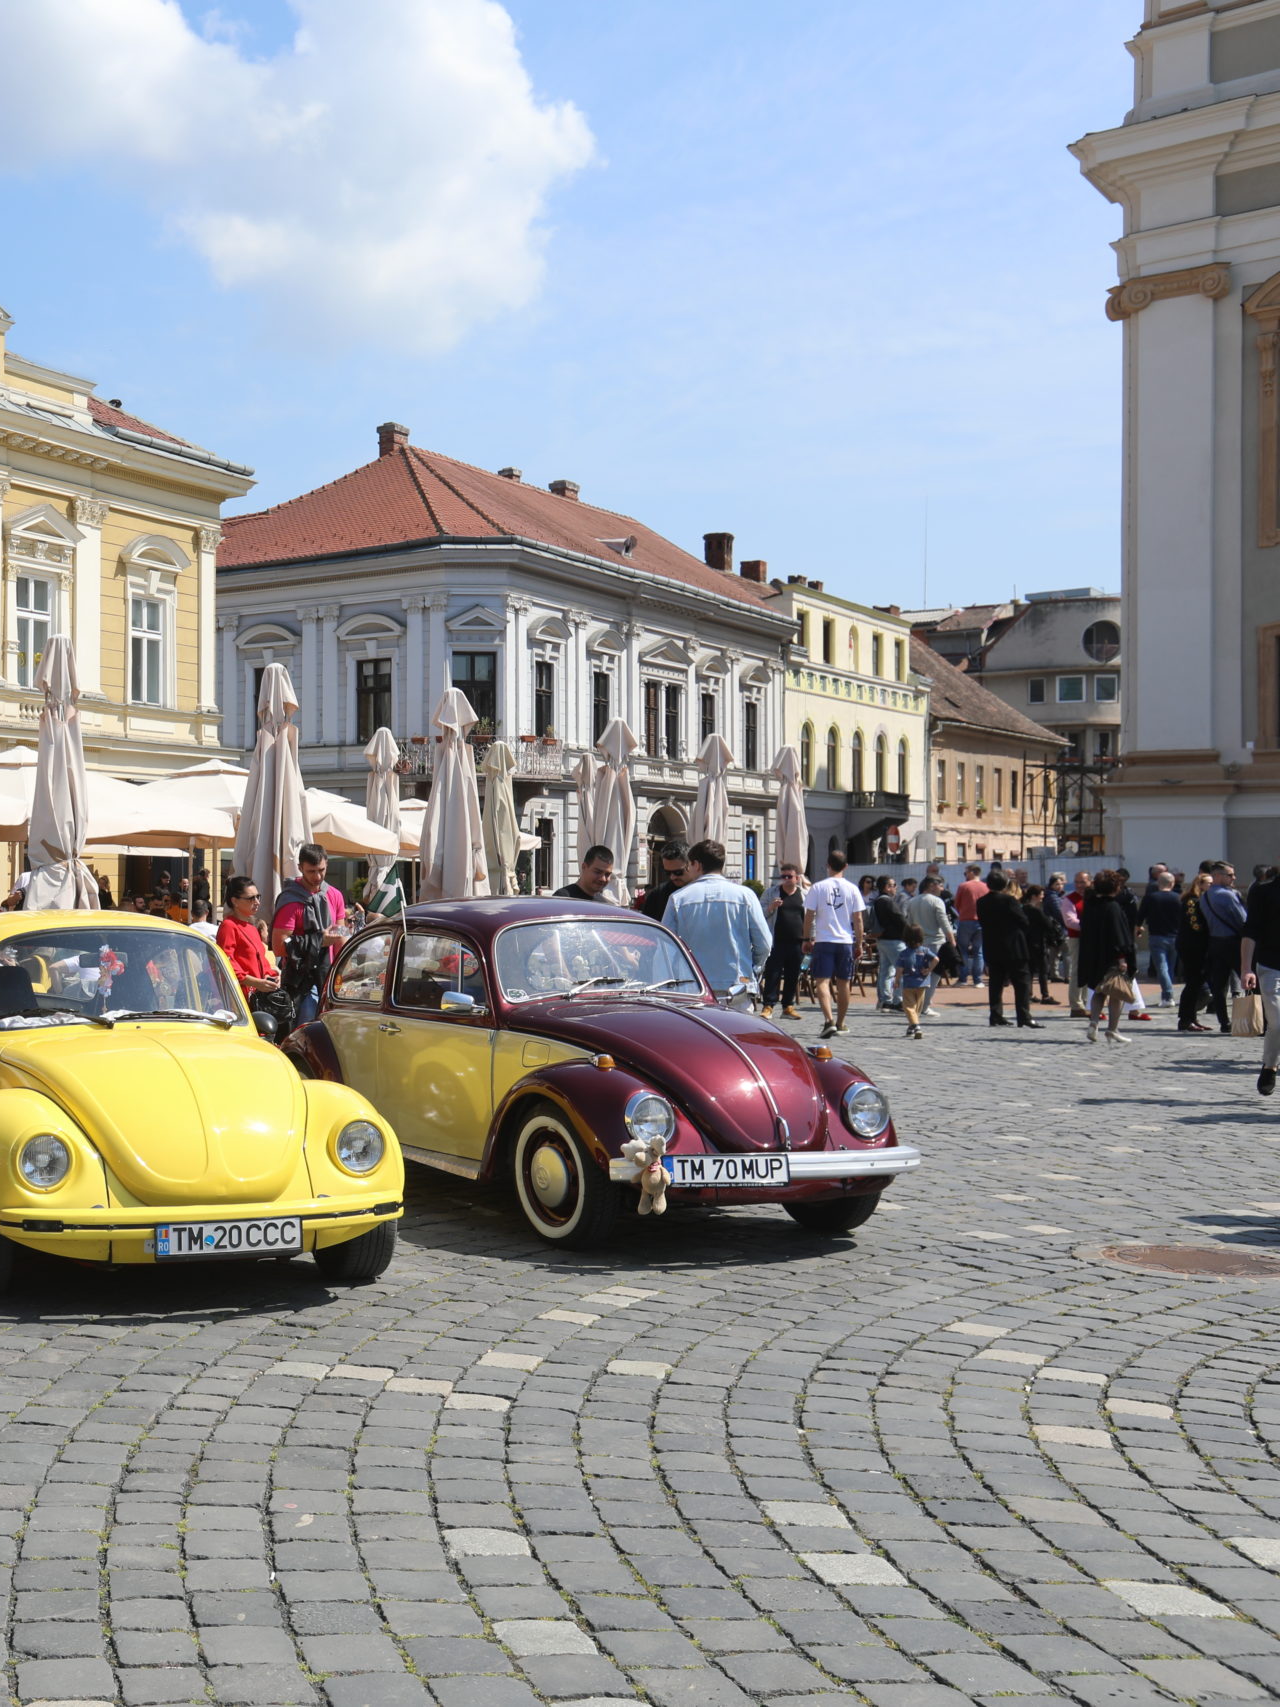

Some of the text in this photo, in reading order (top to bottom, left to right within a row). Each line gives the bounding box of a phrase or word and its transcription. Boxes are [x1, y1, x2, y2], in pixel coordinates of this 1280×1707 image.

[677, 1159, 705, 1180] TM
[158, 1241, 169, 1252] RO
[173, 1227, 204, 1251] TM
